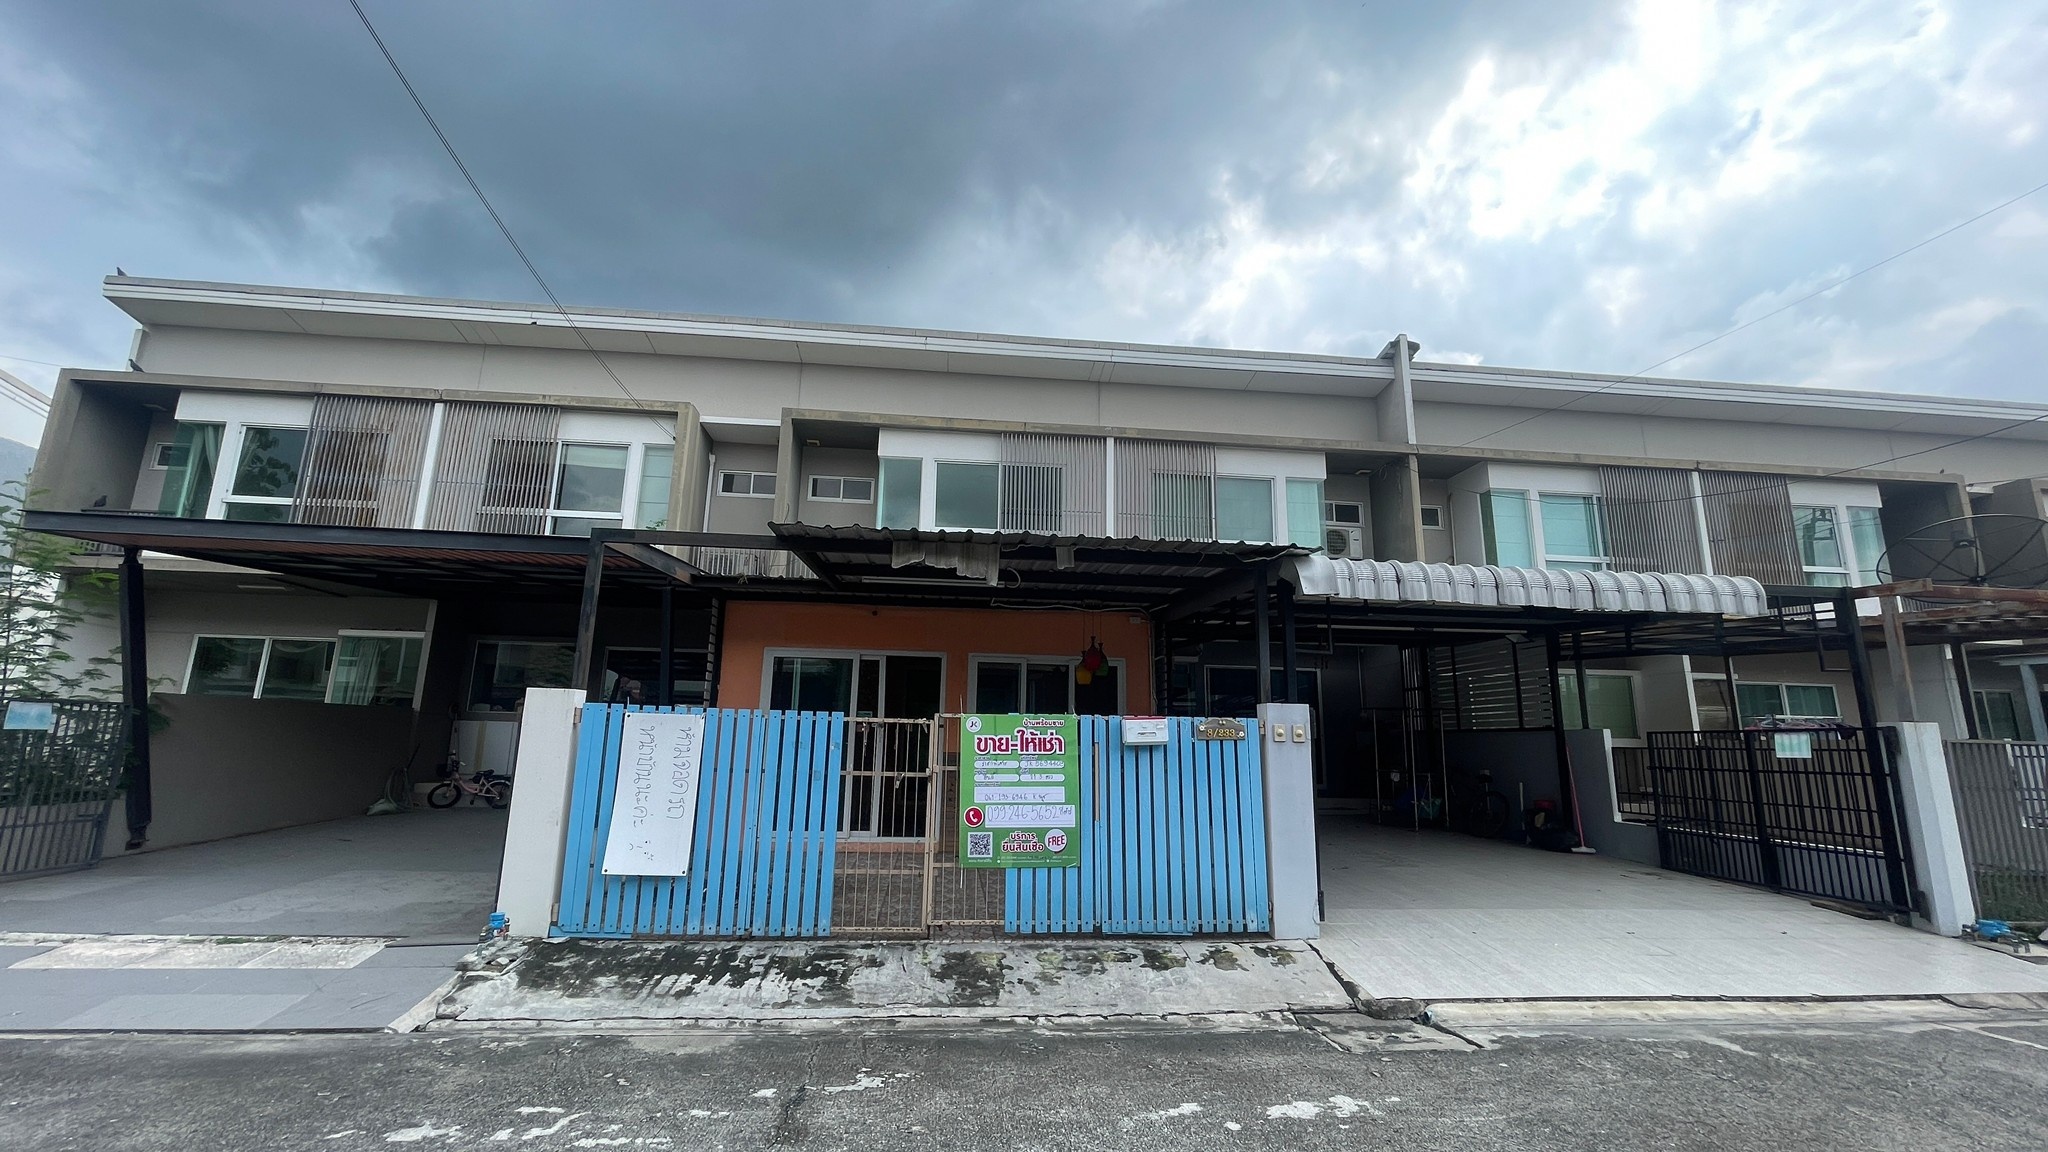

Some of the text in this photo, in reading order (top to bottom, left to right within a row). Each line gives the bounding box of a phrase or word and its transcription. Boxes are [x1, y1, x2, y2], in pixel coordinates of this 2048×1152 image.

[1023, 718, 1064, 727] บ้านพร้อมขาย
[975, 728, 1064, 753] ขาย-ให้เช่า
[1010, 831, 1036, 841] บริการ
[1047, 834, 1066, 847] FREE
